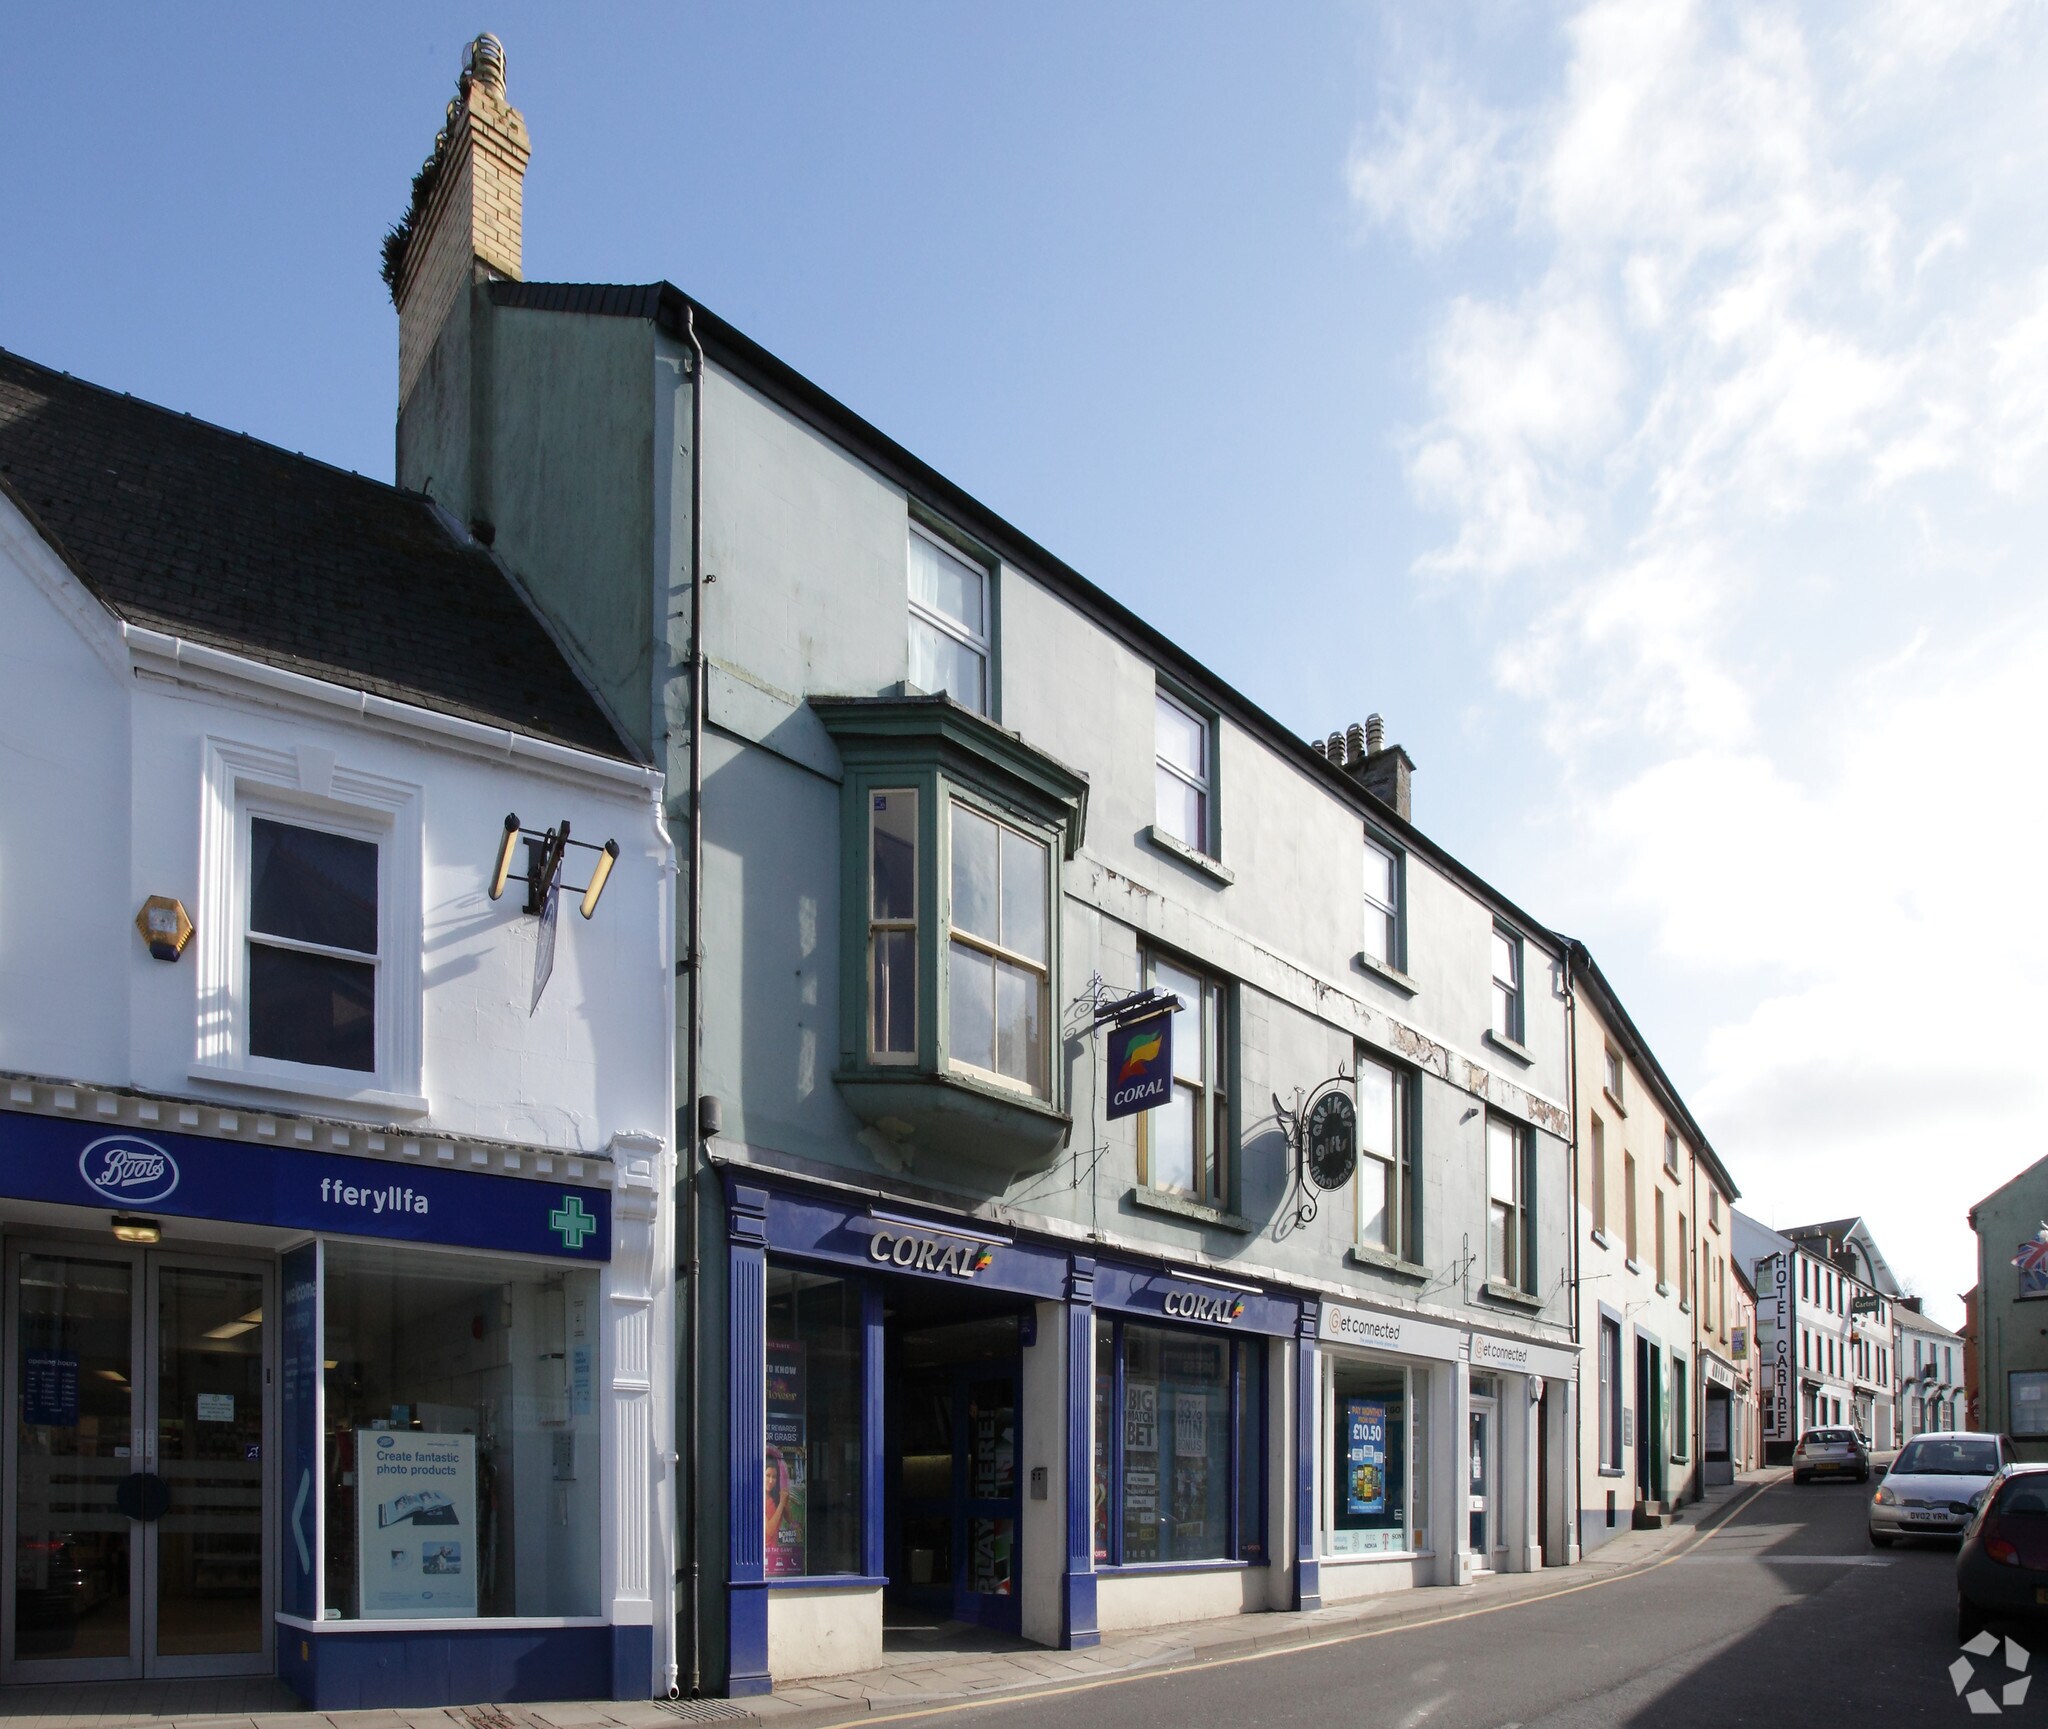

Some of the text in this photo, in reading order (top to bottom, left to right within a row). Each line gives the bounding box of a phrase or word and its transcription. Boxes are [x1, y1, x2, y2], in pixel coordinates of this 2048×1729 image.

[1114, 1079, 1164, 1105] CORAL
[1316, 1135, 1347, 1161] gifts
[95, 1149, 164, 1187] Boots
[321, 1178, 429, 1214] fferyllfa
[870, 1231, 978, 1277] CORAL
[1165, 1290, 1232, 1323] CORAL
[1855, 1299, 1877, 1309] Cartref
[1329, 1309, 1400, 1339] Get connected
[1475, 1337, 1527, 1362] Get connected
[1776, 1255, 1788, 1439] HOTEL CARTREF
[28, 1357, 77, 1367] opening hours
[775, 1364, 797, 1375] KNOW
[1129, 1389, 1152, 1412] BIG
[1178, 1399, 1202, 1420] 33%
[771, 1424, 797, 1432] REWARDS
[1128, 1411, 1154, 1423] MATCH
[1127, 1422, 1154, 1446] BET
[1178, 1420, 1202, 1439] WIN
[1353, 1423, 1381, 1441] £10.50
[376, 1450, 459, 1463] Create fantastic
[376, 1464, 456, 1476] photo products
[977, 1518, 995, 1594] PLAY
